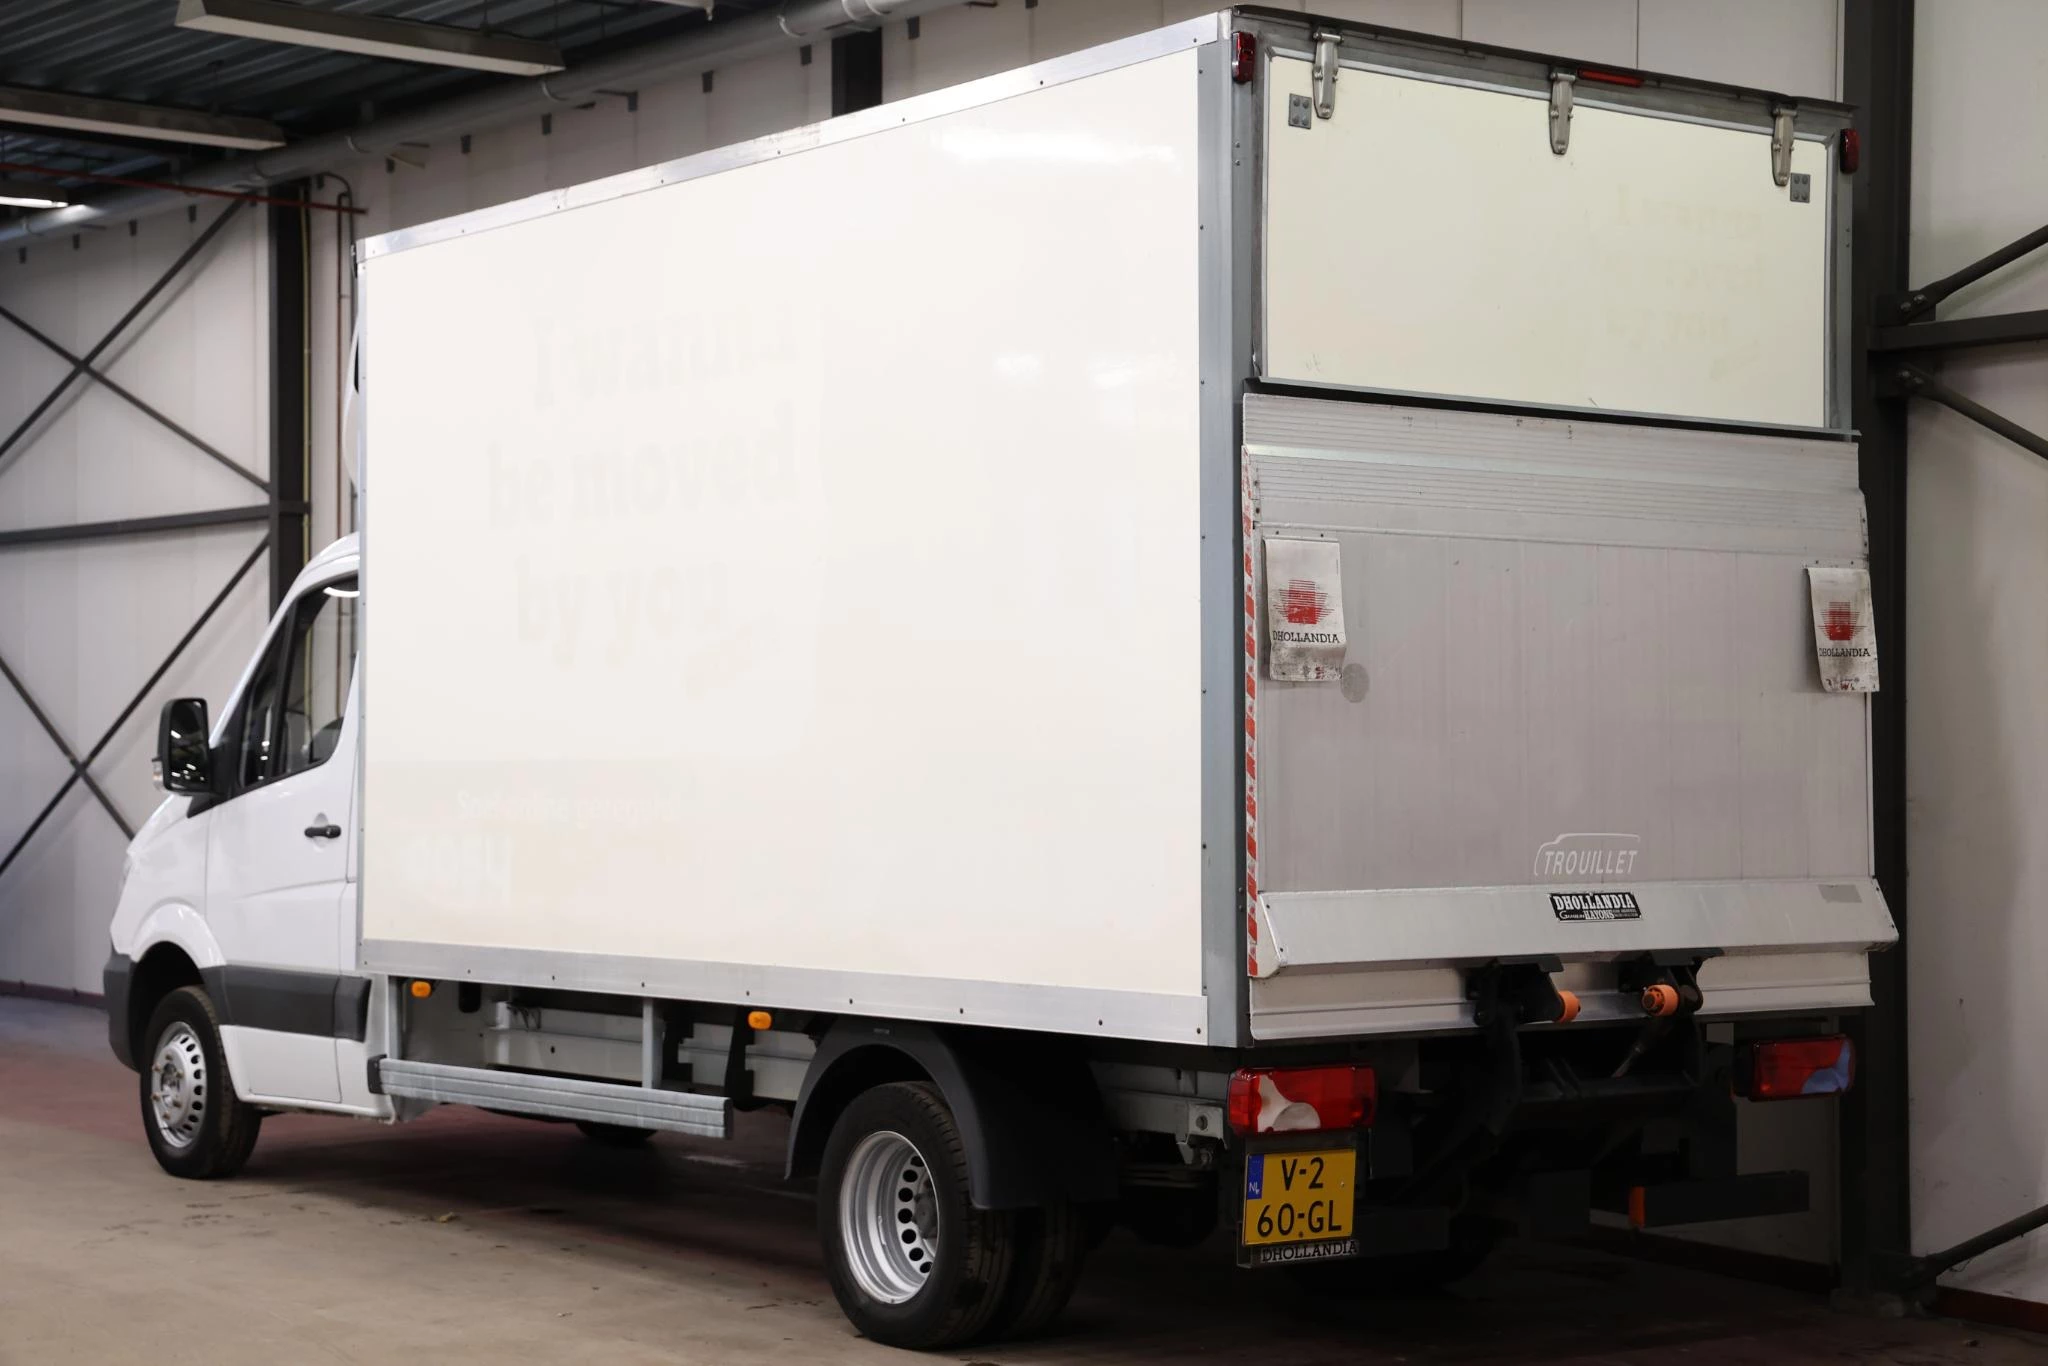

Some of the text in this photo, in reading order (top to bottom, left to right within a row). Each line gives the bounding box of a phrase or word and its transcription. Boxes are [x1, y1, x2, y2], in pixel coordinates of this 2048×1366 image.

[1272, 629, 1340, 643] DHOLLANDIA
[1544, 850, 1639, 875] TROUILLET
[1552, 894, 1636, 910] DHOLLANDIA
[1583, 910, 1615, 920] HAYONS
[1281, 1156, 1325, 1191] V-2
[1249, 1181, 1259, 1194] NL
[1257, 1200, 1342, 1238] 60-GL
[1262, 1241, 1358, 1261] DHOLLANDIA
